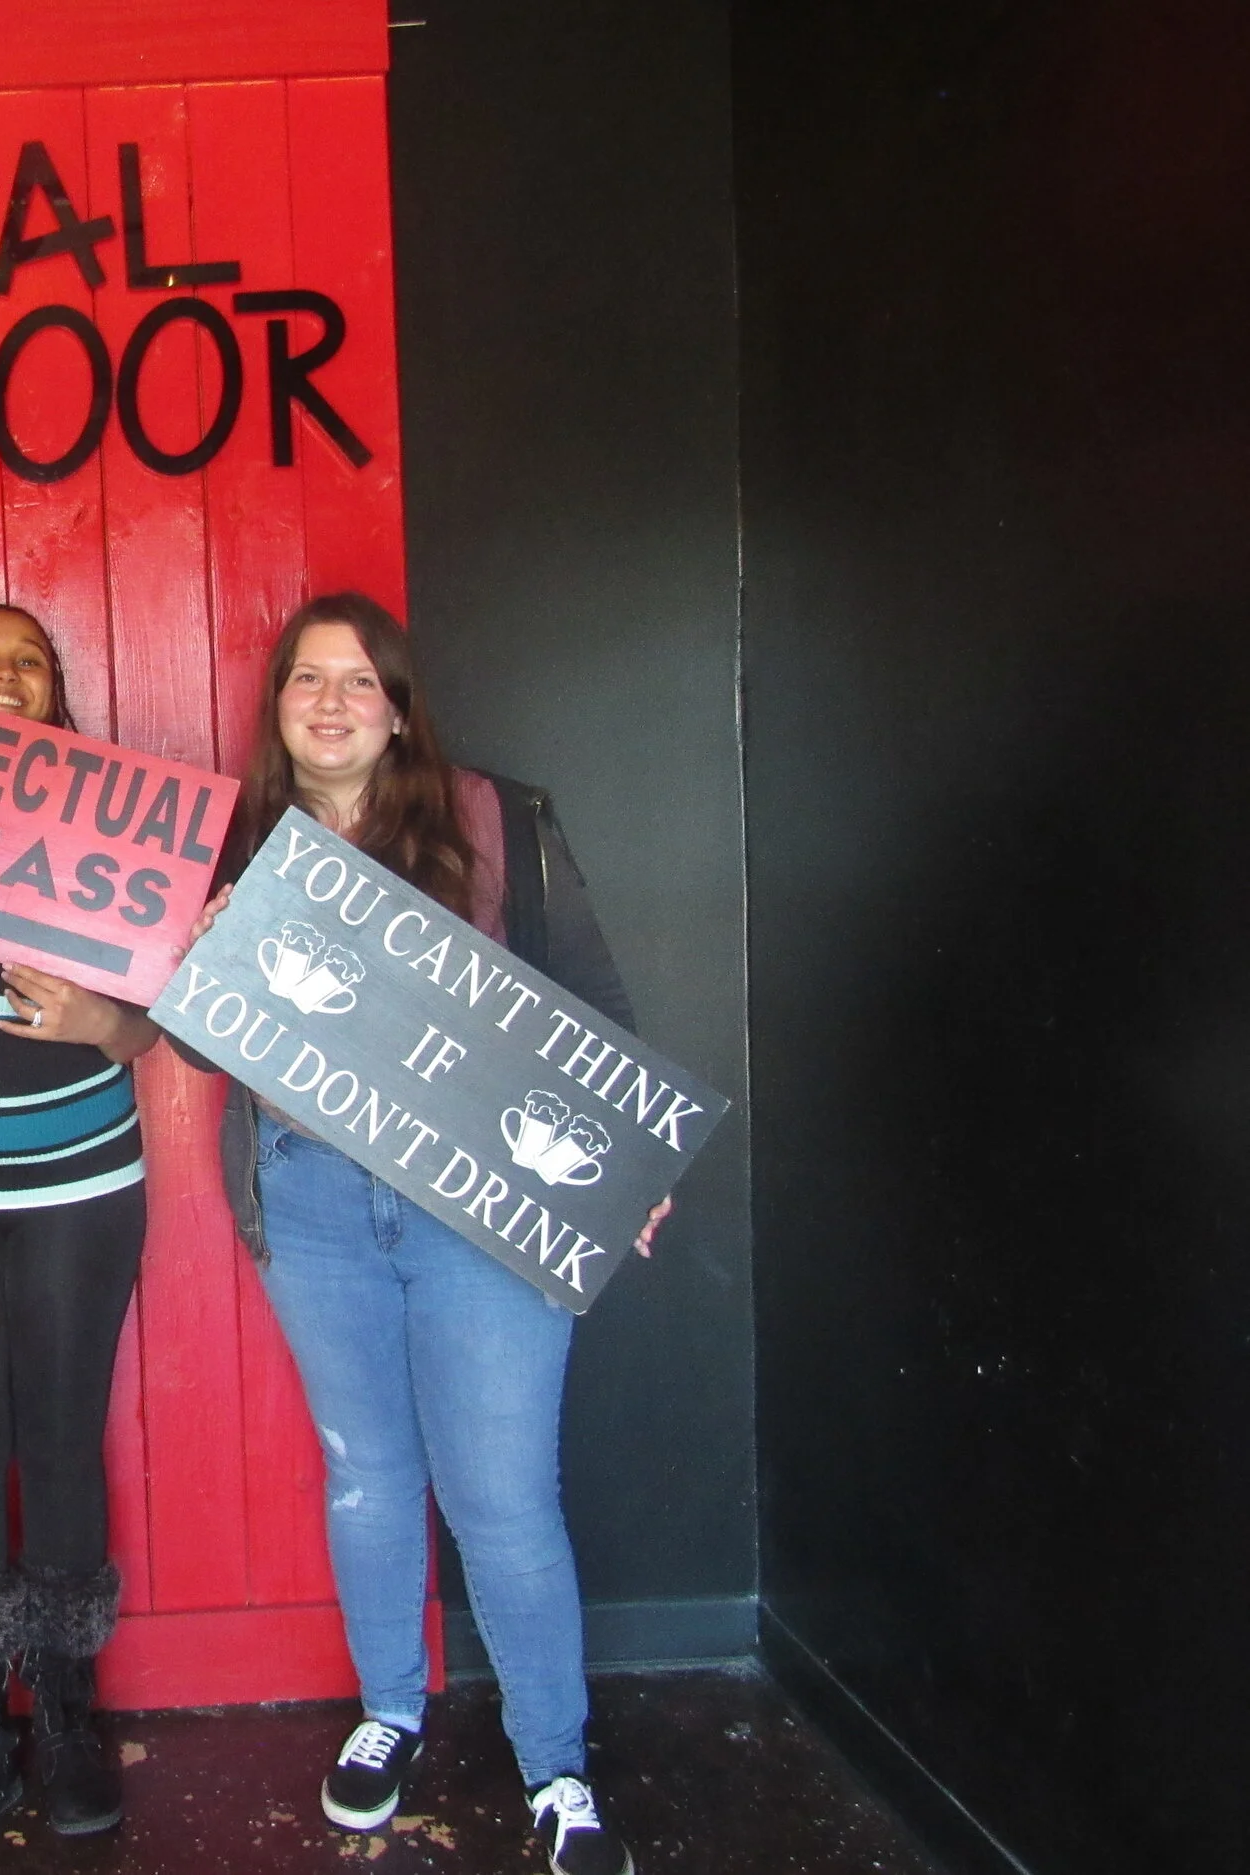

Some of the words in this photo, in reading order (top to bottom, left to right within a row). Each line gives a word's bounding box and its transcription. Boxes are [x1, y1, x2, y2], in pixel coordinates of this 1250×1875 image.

[173, 964, 289, 1062] YOU
[276, 1040, 440, 1171] DON'T
[428, 1146, 606, 1294] DRINK
[273, 826, 389, 926] YOU
[383, 909, 541, 1033] CAN'T
[534, 1008, 704, 1152] THINK
[399, 1023, 468, 1084] IF
